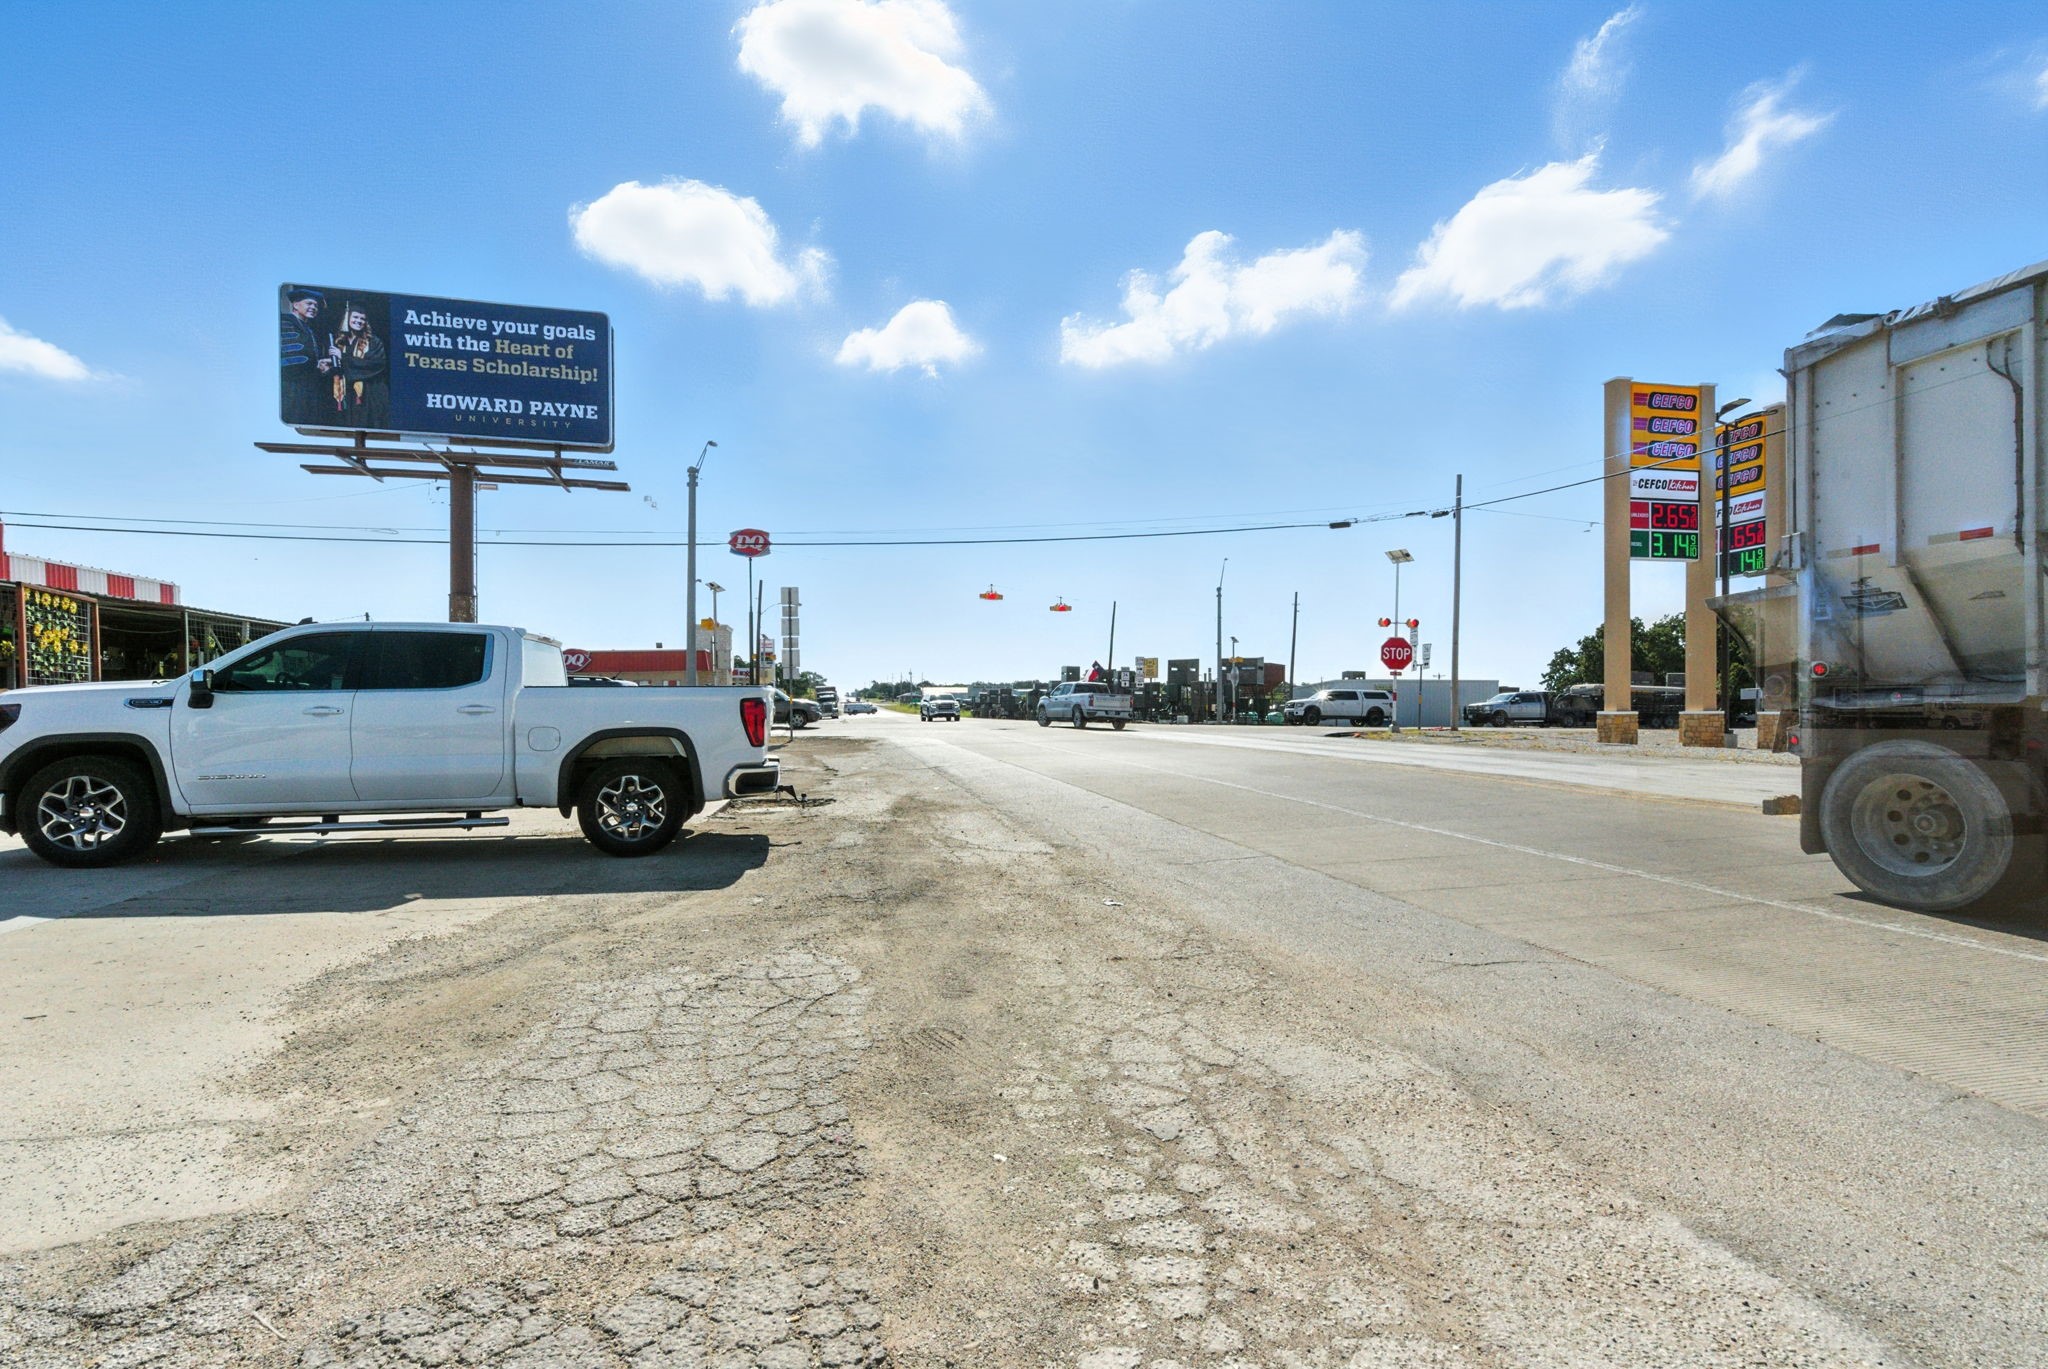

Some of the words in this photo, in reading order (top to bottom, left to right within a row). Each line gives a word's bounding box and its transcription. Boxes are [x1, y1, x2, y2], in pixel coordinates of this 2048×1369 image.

[404, 310, 488, 331] Achieve
[492, 320, 540, 335] your
[543, 325, 596, 341] goals
[404, 332, 453, 349] with
[457, 336, 490, 352] the
[495, 339, 551, 358] Heart
[555, 344, 574, 359] of
[404, 353, 467, 372] Texas
[472, 358, 598, 384] Scholarship!
[426, 393, 523, 414] HOWARD
[529, 401, 598, 420] PAYNE
[1652, 393, 1694, 410] CEFCO
[455, 414, 571, 429] UNIVERSITY
[1652, 418, 1694, 434] CEFCO
[1651, 442, 1694, 457] CEFCO
[1638, 478, 1668, 490] CEFCO
[1652, 503, 1690, 529] 2.65
[735, 534, 765, 551] DQ
[1653, 533, 1689, 557] 3.14
[563, 653, 585, 667] DQ
[1382, 647, 1411, 660] STOP
